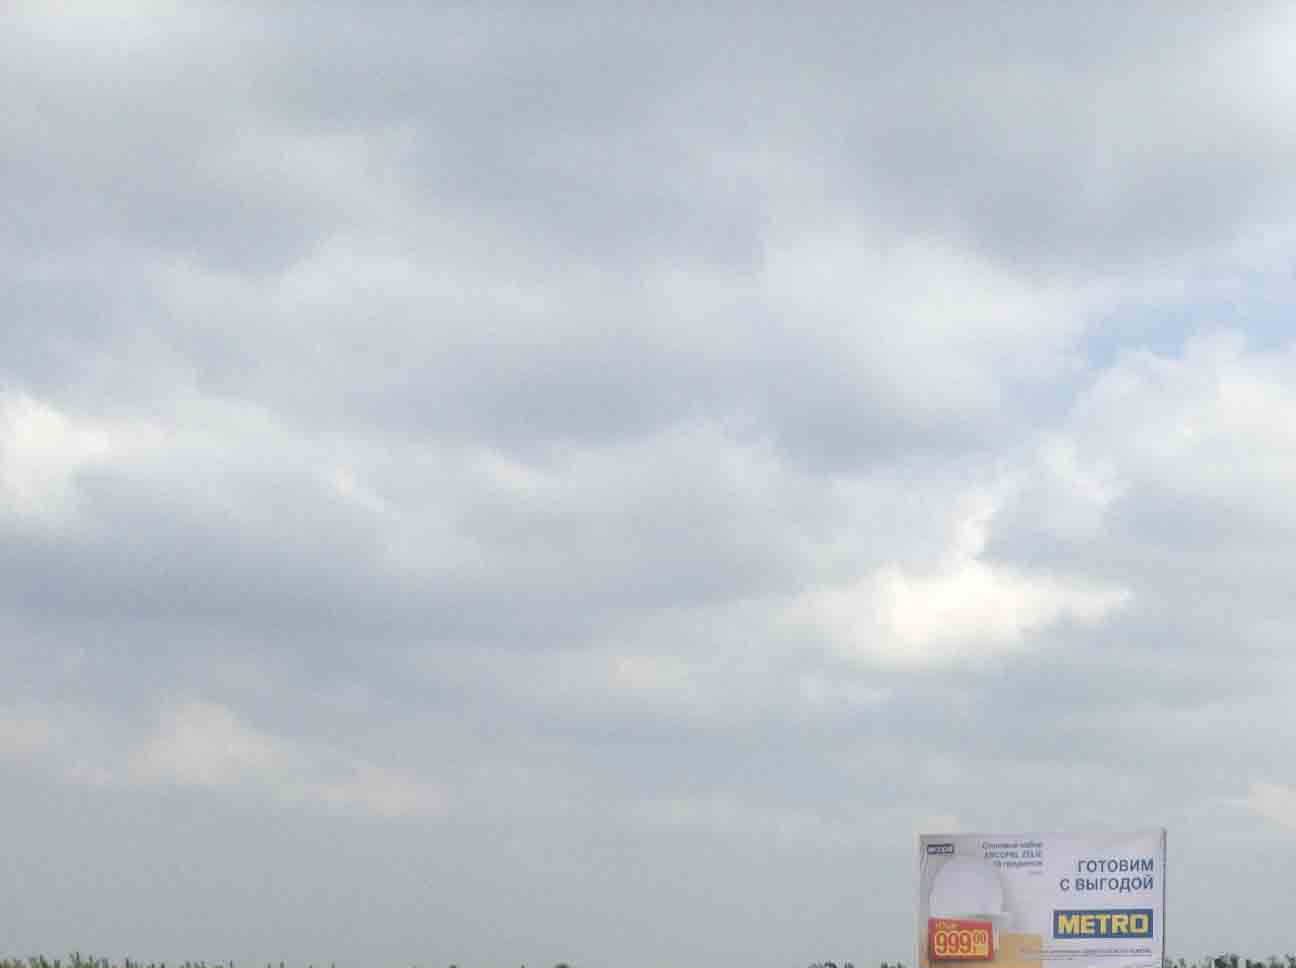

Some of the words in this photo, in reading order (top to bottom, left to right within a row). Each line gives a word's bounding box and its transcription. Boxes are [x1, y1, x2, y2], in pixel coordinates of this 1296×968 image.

[1078, 859, 1154, 873] ГОТОВИМ
[1060, 879, 1070, 891] С
[1075, 877, 1154, 893] ВЫГОДОЙ
[1058, 914, 1149, 934] METRO
